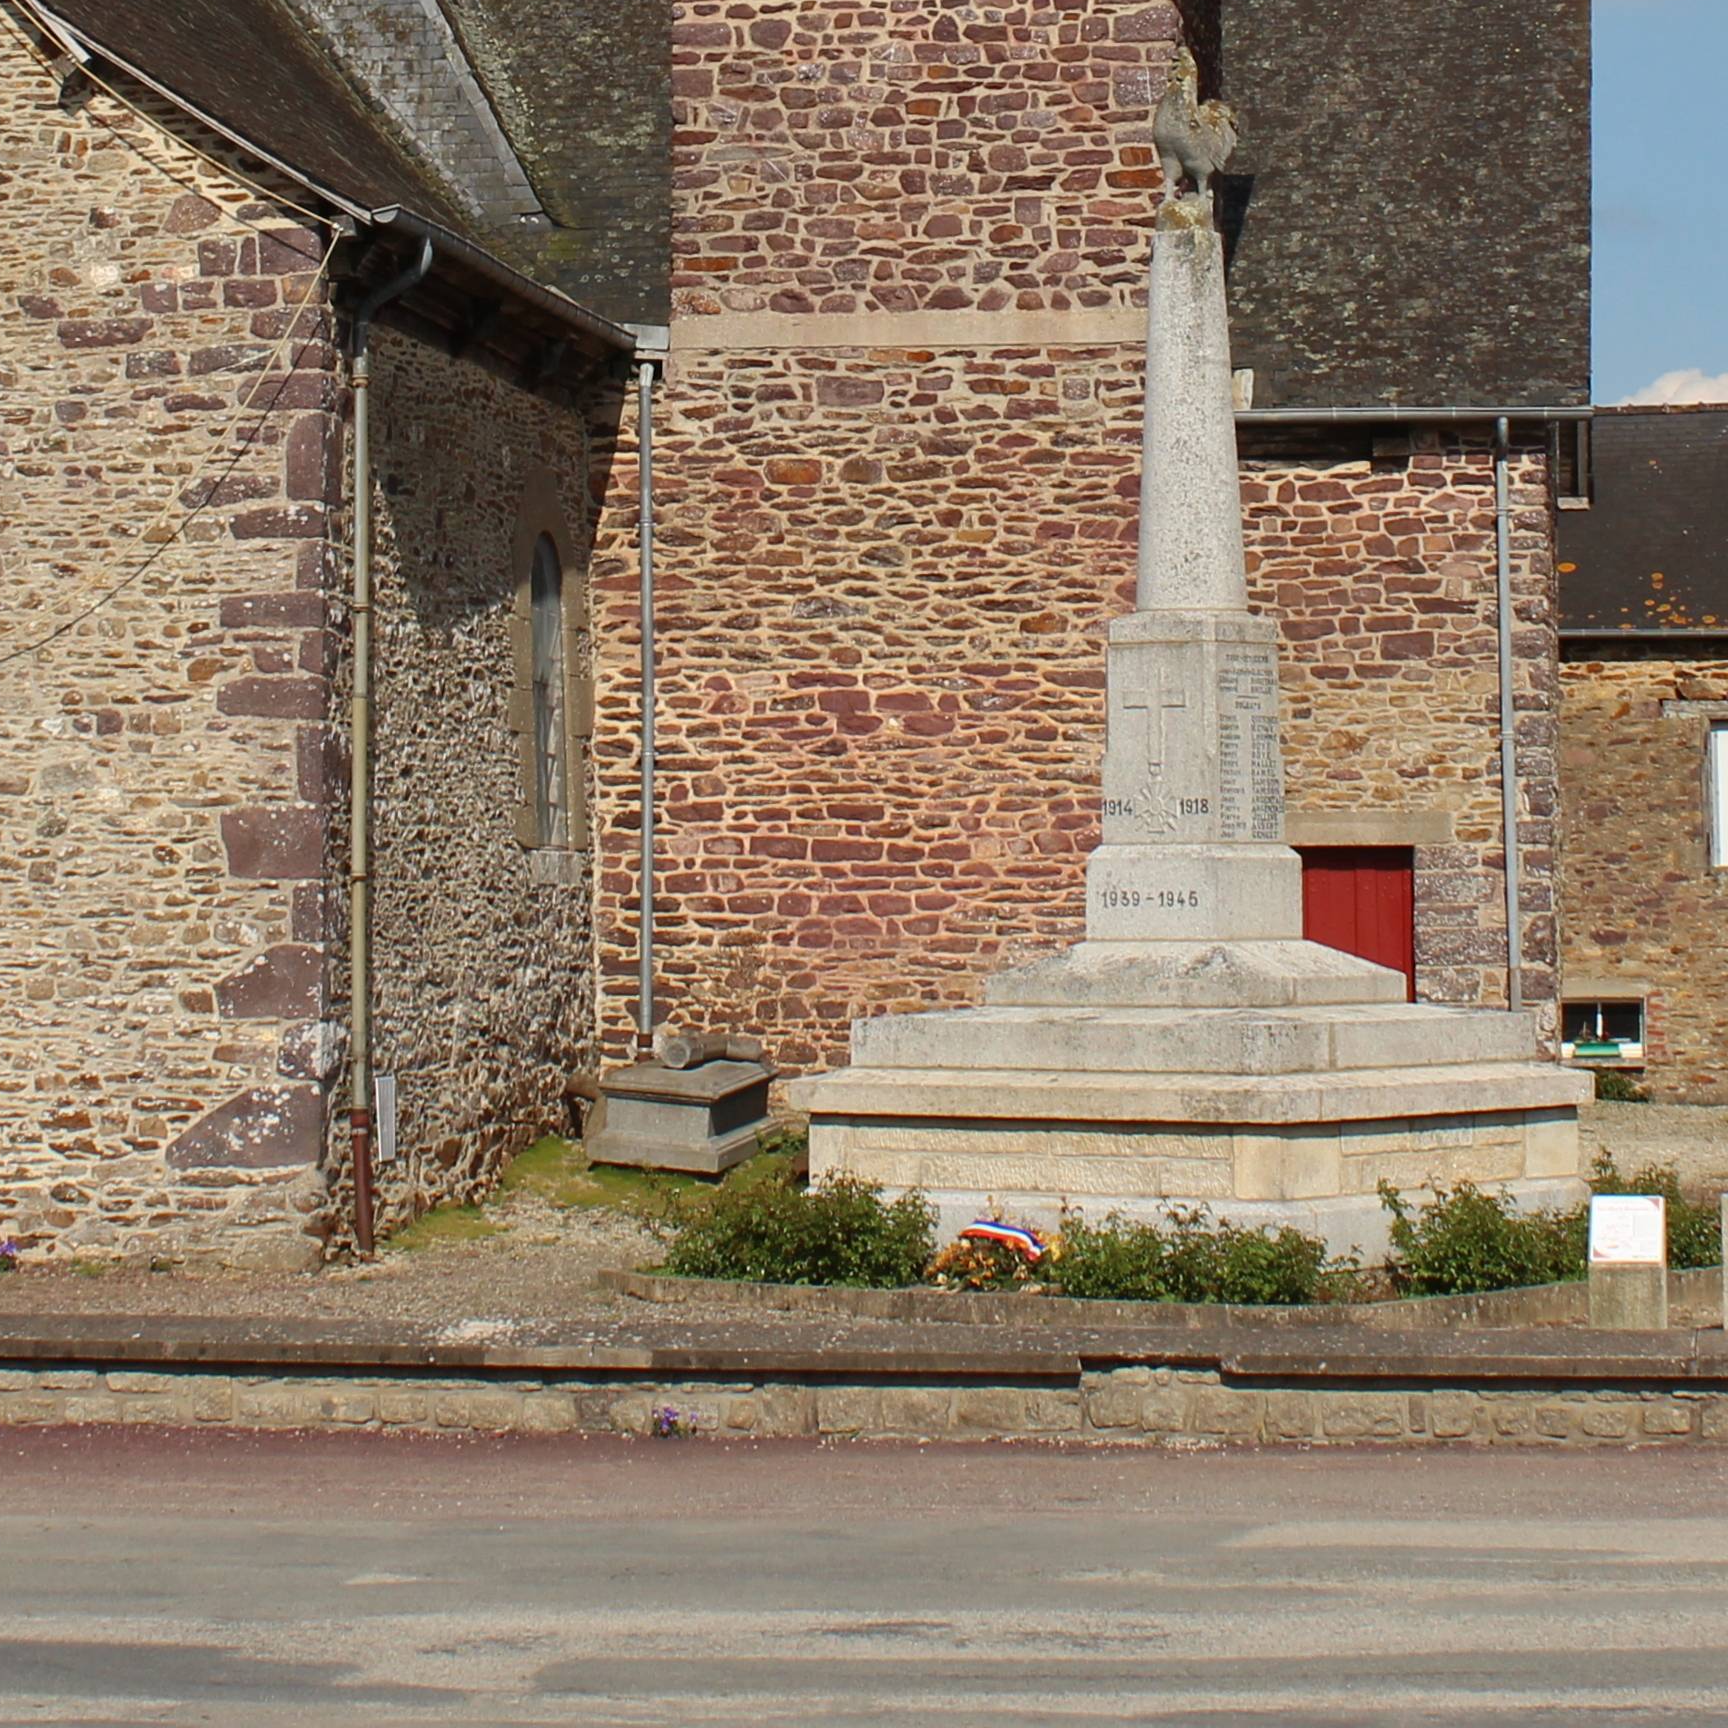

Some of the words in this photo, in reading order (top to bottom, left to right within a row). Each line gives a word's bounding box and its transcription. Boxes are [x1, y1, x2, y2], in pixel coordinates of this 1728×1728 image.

[1103, 799, 1133, 816] 1914
[1179, 798, 1209, 815] 1918
[1101, 890, 1140, 909] 1939
[1158, 890, 1199, 908] 1945
